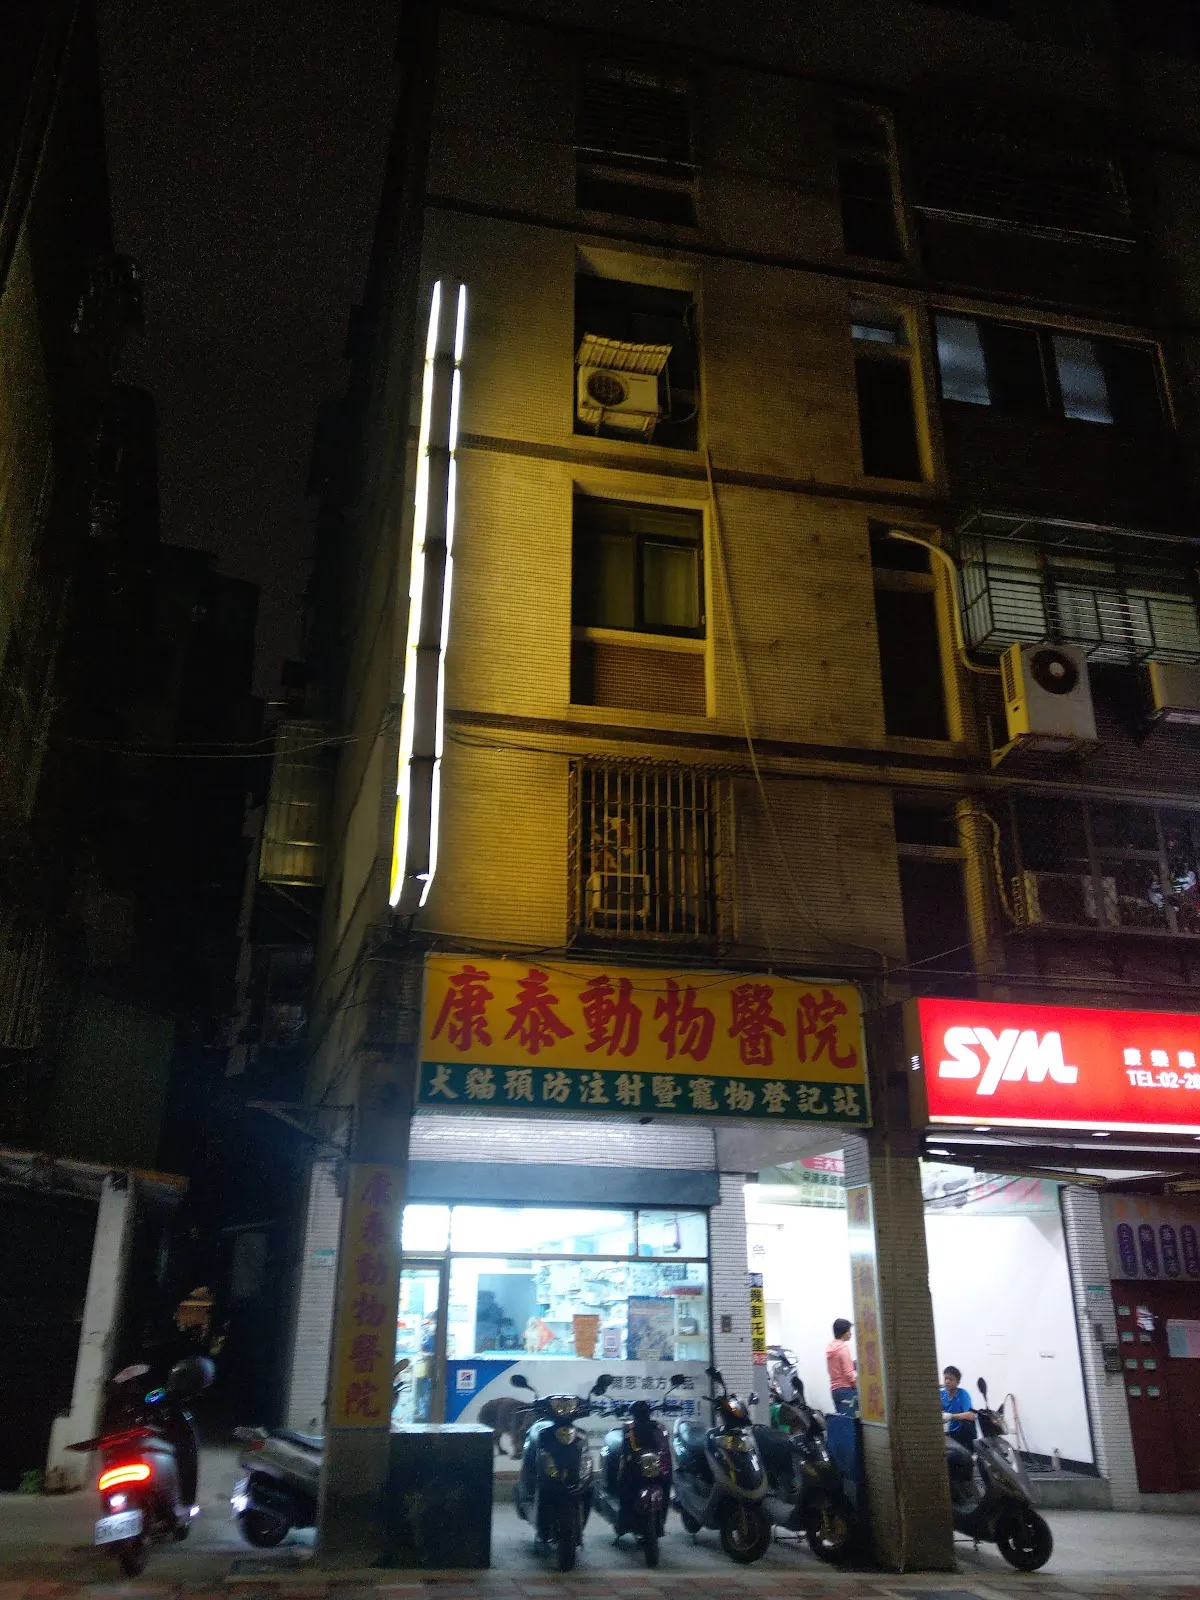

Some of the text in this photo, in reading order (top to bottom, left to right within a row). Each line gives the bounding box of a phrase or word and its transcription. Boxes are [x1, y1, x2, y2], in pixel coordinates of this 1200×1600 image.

[430, 965, 857, 1069] 康泰動物醫院
[428, 1065, 861, 1117] 犬貓預防注射暨寵物登記站
[938, 1027, 1078, 1095] SYM
[344, 1171, 392, 1418] 康泰動物醫院
